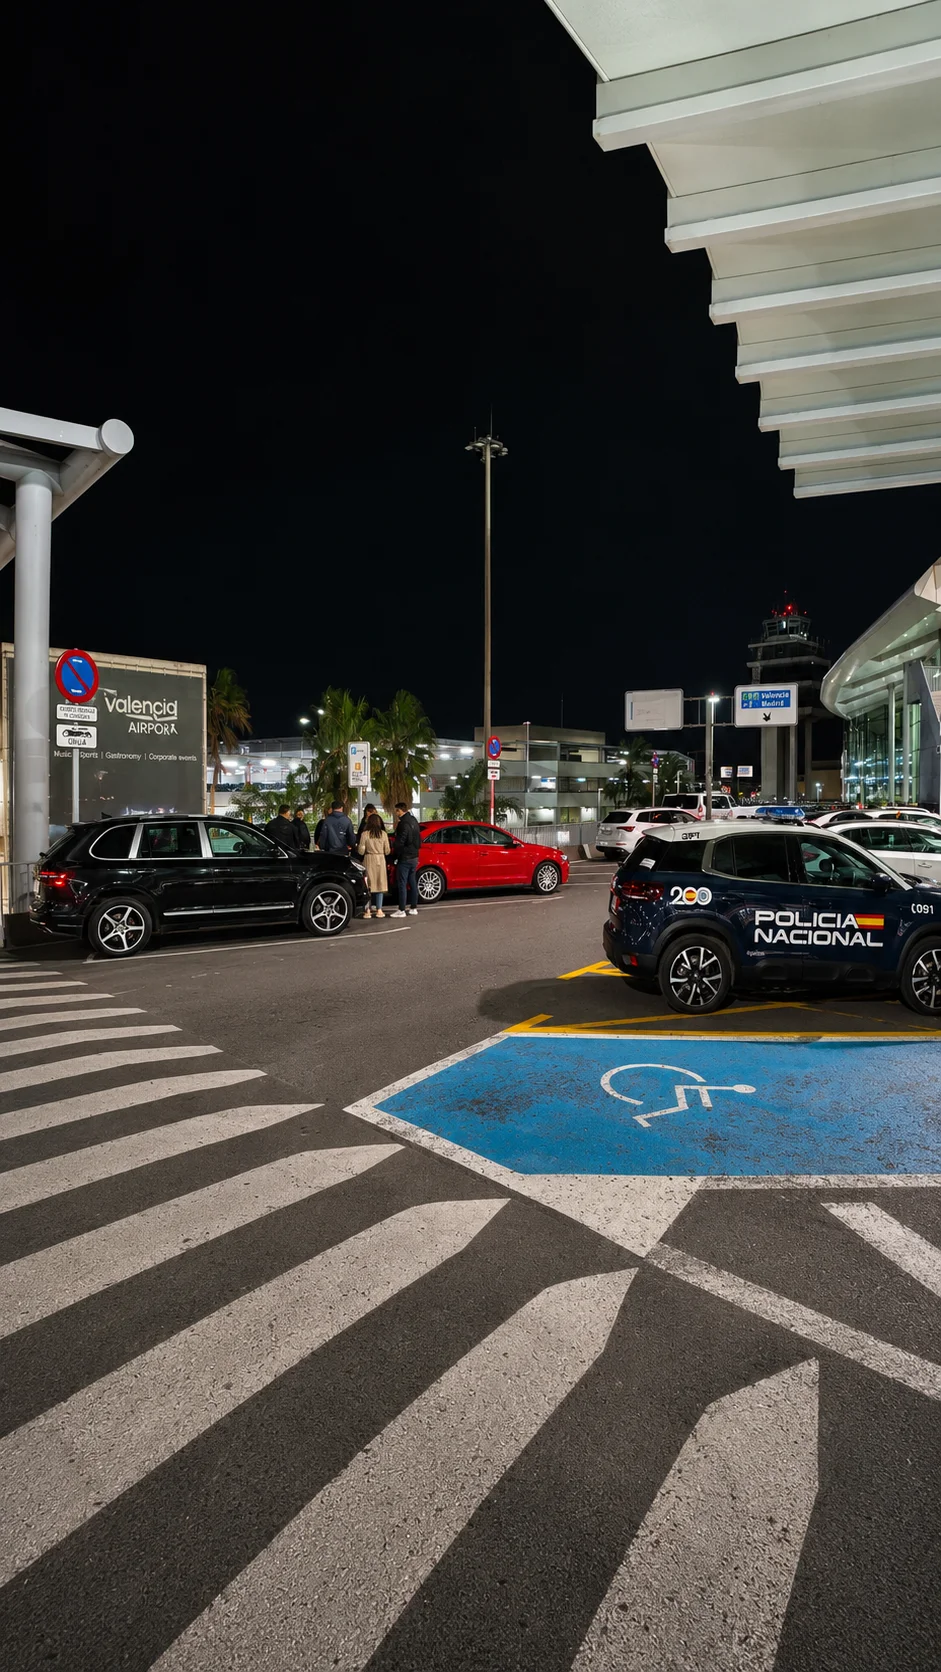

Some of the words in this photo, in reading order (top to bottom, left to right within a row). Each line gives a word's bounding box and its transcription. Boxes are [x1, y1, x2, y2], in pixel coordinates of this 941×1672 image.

[103, 692, 178, 717] Valencia
[105, 751, 142, 761] Gastronomy
[668, 886, 713, 906] 200
[754, 910, 859, 929] POLICIA
[754, 928, 884, 948] NACIONAL
